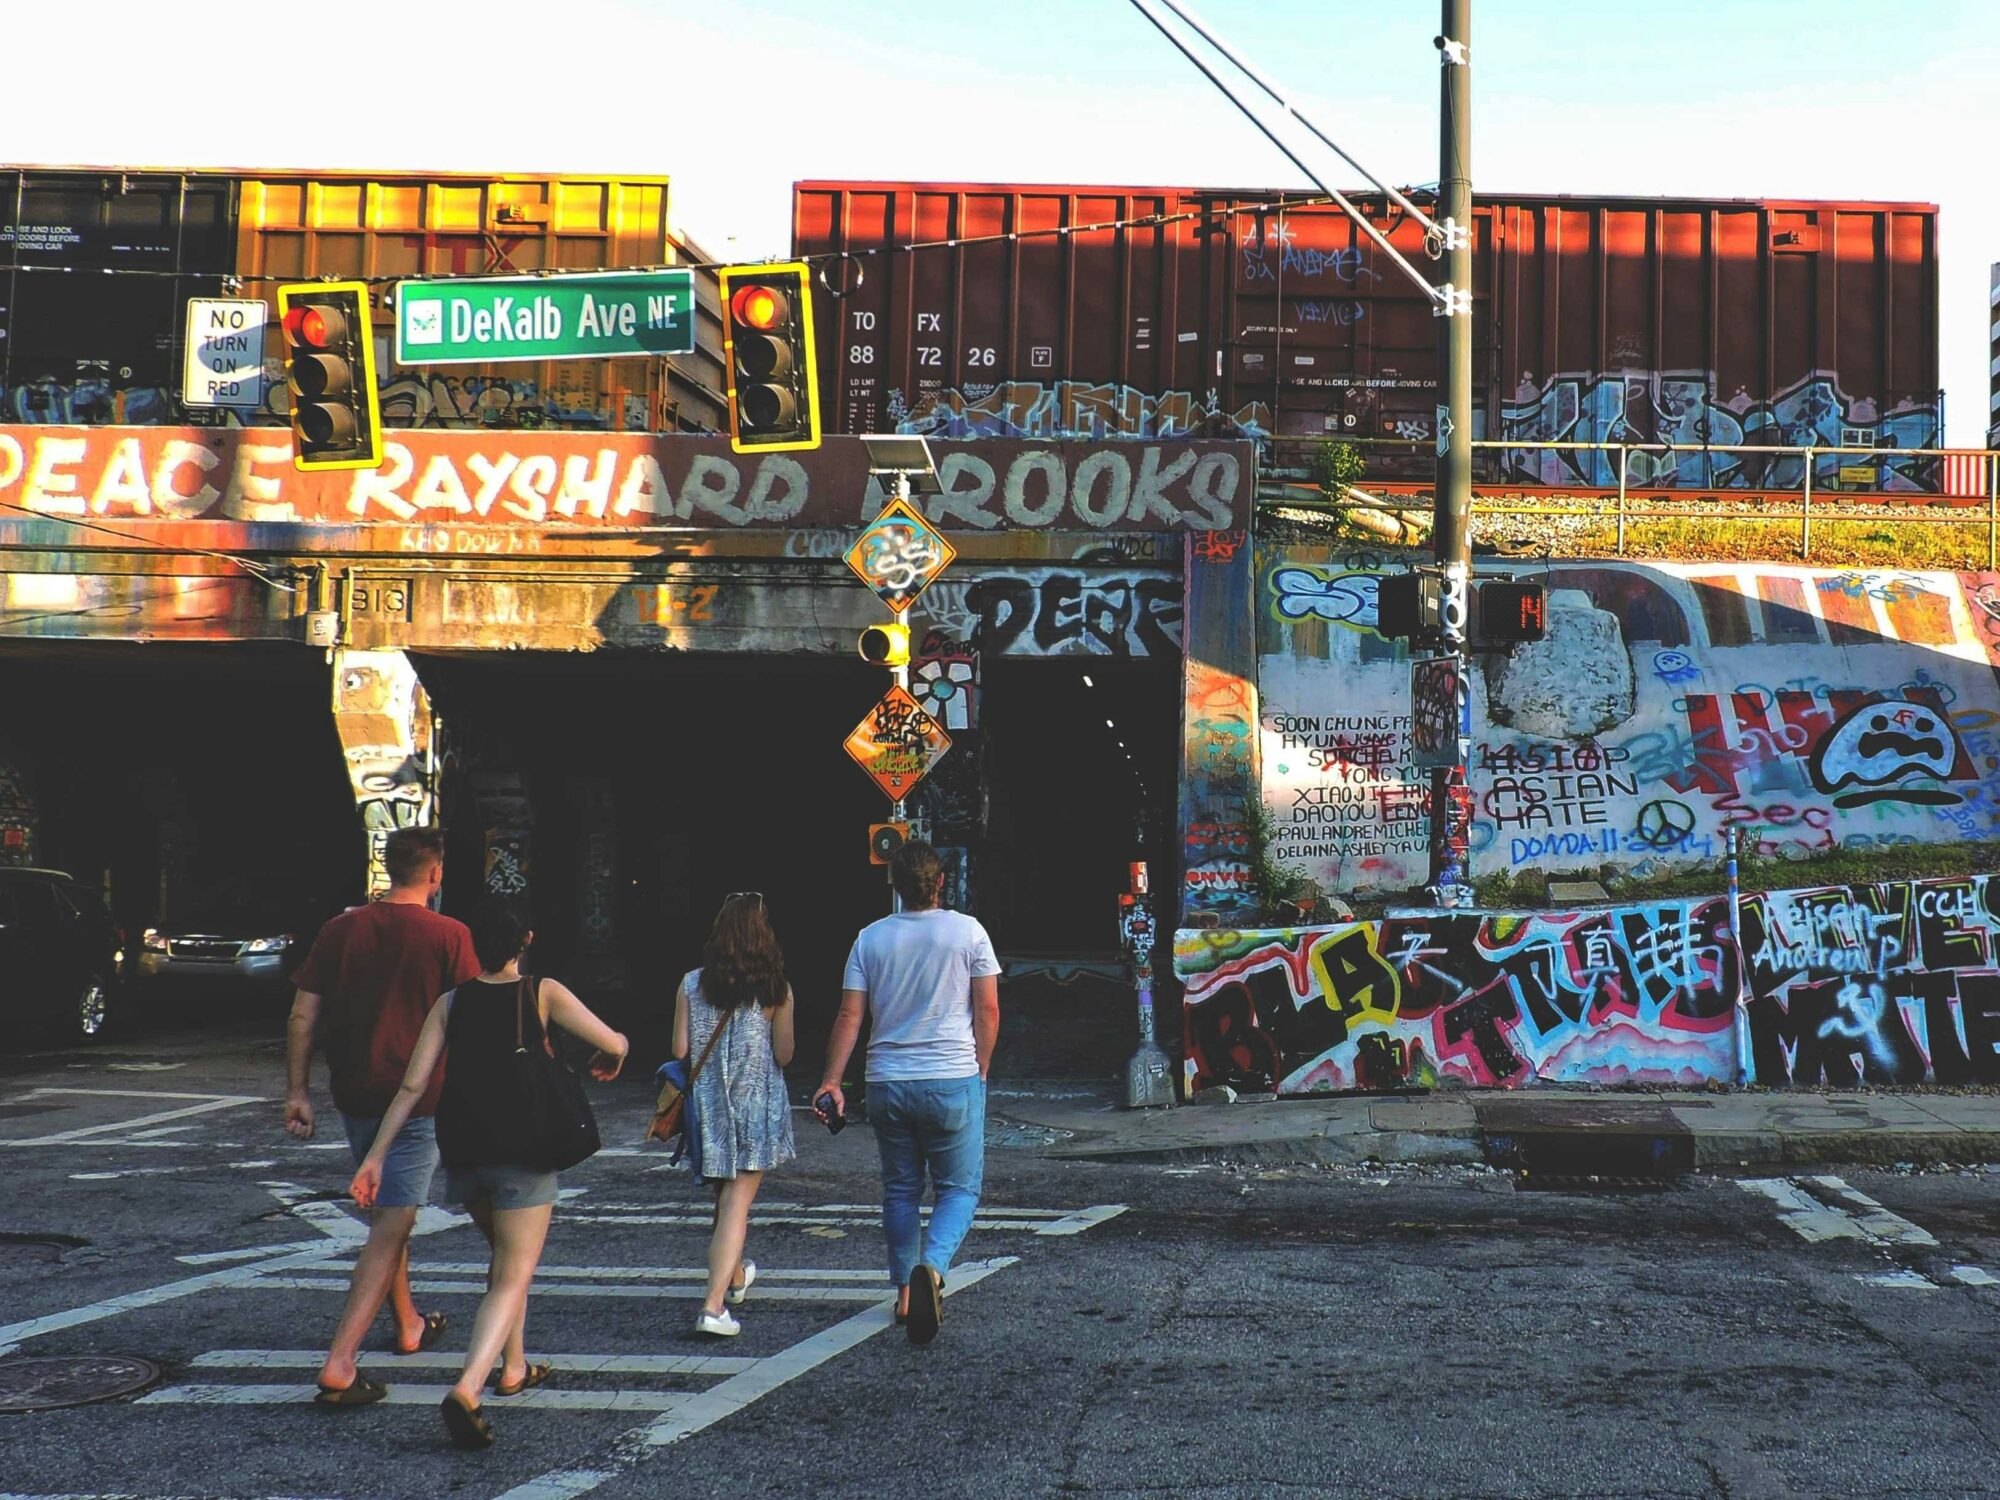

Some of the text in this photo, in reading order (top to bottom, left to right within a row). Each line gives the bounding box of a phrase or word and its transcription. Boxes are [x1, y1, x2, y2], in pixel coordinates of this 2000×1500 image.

[4, 225, 30, 234] CLSE
[211, 309, 244, 330] NO
[450, 293, 678, 344] DeKalb Ave NE
[853, 311, 941, 332] TO FX
[204, 334, 248, 353] TURN
[212, 357, 237, 374] ON
[849, 345, 995, 367] 88 72 26
[207, 379, 241, 397] RED
[1366, 379, 1397, 388] BEFORE
[1423, 380, 1438, 388] CAR
[345, 439, 810, 527] RAYSHARD
[1521, 594, 1542, 629] 14
[1273, 716, 1320, 733] SOON
[1324, 715, 1390, 731] CHUNG
[1282, 733, 1344, 749] HYUN
[1339, 767, 1392, 784] YONG
[1493, 772, 1638, 803] ASIAN
[1292, 803, 1377, 823] DAOYOU
[1494, 799, 1608, 831] HATE
